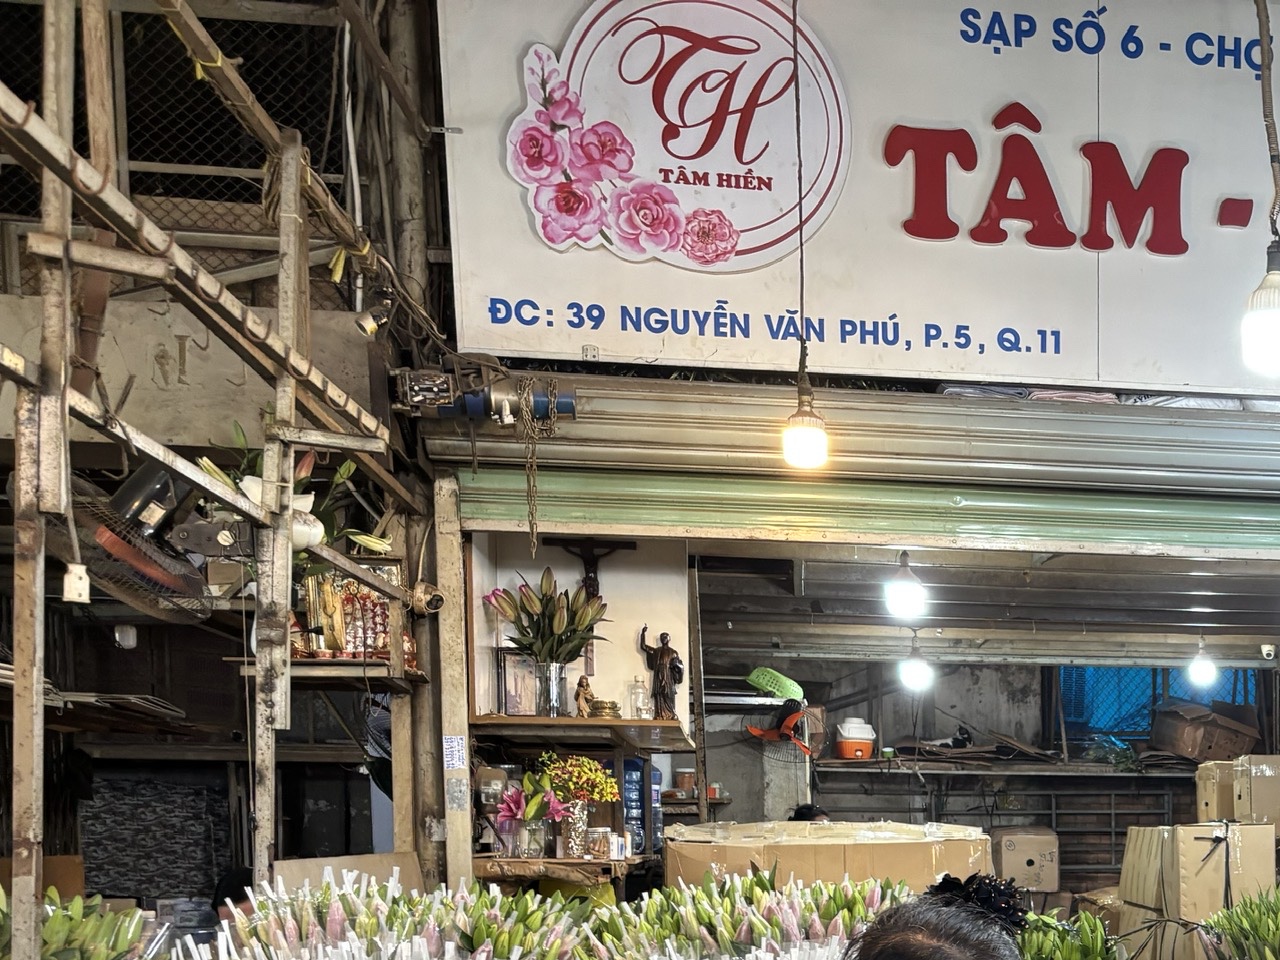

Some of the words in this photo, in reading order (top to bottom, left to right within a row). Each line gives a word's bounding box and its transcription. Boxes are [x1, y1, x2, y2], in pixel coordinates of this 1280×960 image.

[960, 8, 1037, 55] SẠP
[1053, 5, 1107, 55] SỐ
[1120, 24, 1144, 59] 6
[659, 166, 710, 188] TÂM
[716, 168, 773, 192] HIỀN
[884, 101, 1190, 258] TÂM
[567, 302, 605, 329] 39
[620, 300, 750, 340] NGUYỄN
[765, 310, 825, 342] VĂN
[840, 313, 911, 349] PHÚ,
[996, 327, 1061, 355] Q.11
